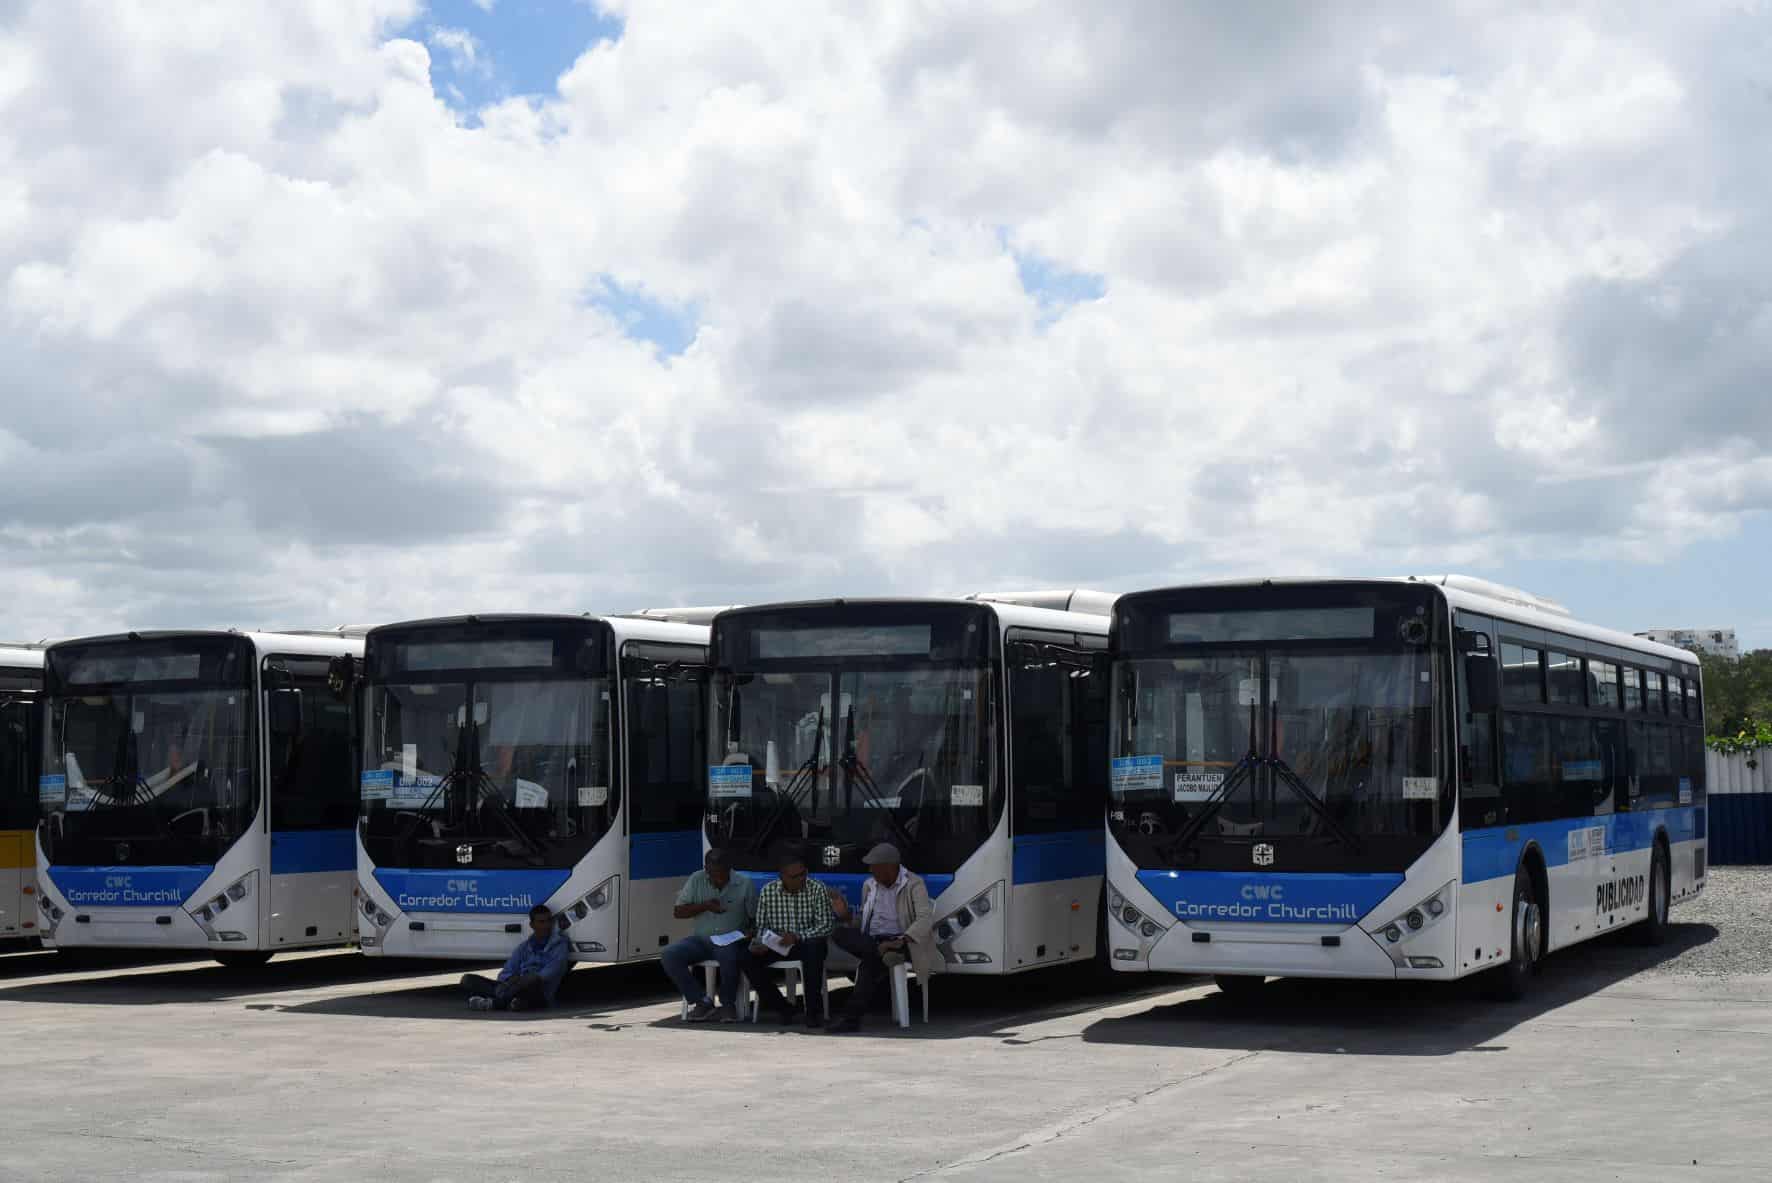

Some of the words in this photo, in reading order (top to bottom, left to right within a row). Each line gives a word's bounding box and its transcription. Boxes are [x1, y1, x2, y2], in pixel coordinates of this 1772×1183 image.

[105, 876, 132, 888] CWC
[447, 880, 477, 892] CWC
[68, 889, 120, 901] Corredor
[123, 888, 182, 901] Churchill
[1241, 885, 1284, 899] CWC
[1596, 874, 1644, 915] PUBLICIDAD
[399, 894, 461, 906] Corredor
[465, 894, 533, 907] Churchill
[1175, 901, 1262, 917] Corredor
[1268, 903, 1357, 919] Churchill
